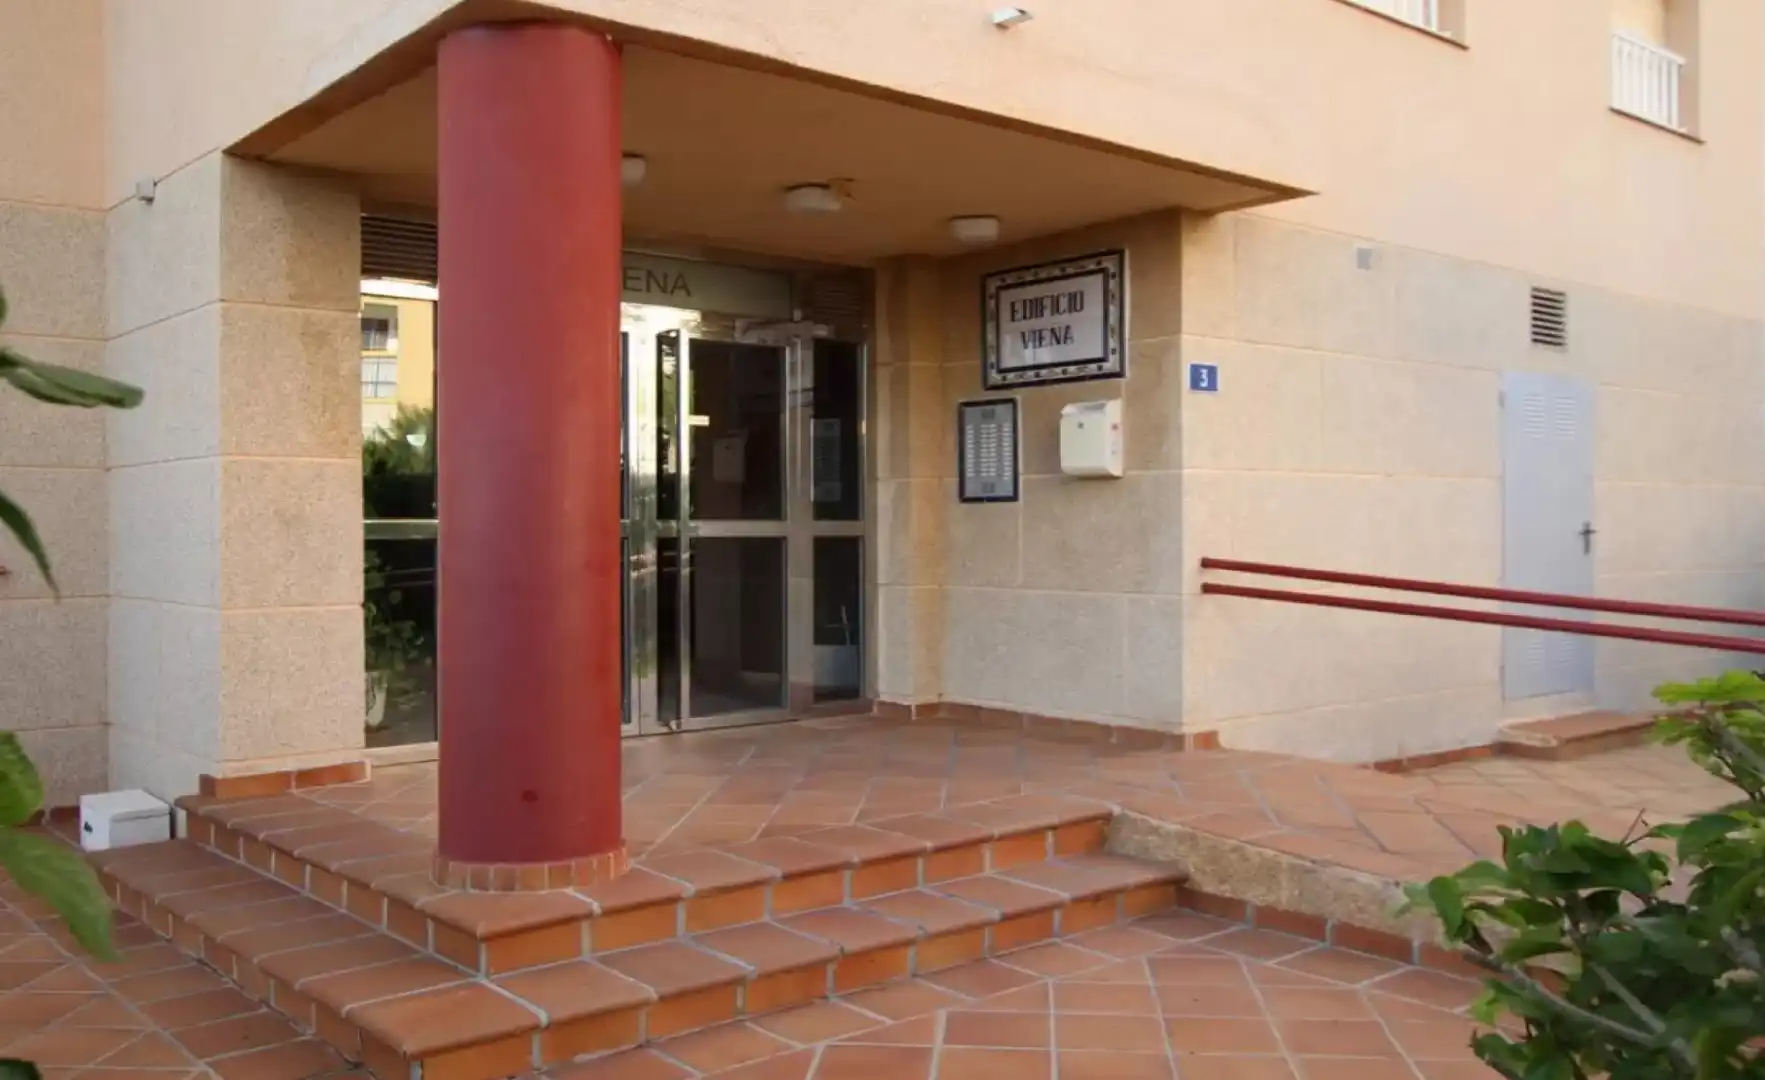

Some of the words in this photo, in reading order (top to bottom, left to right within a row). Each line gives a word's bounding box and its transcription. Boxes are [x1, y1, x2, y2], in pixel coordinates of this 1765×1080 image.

[1010, 291, 1085, 323] EDIFICIO
[1020, 324, 1074, 350] VIENA
[1199, 368, 1209, 388] 3
